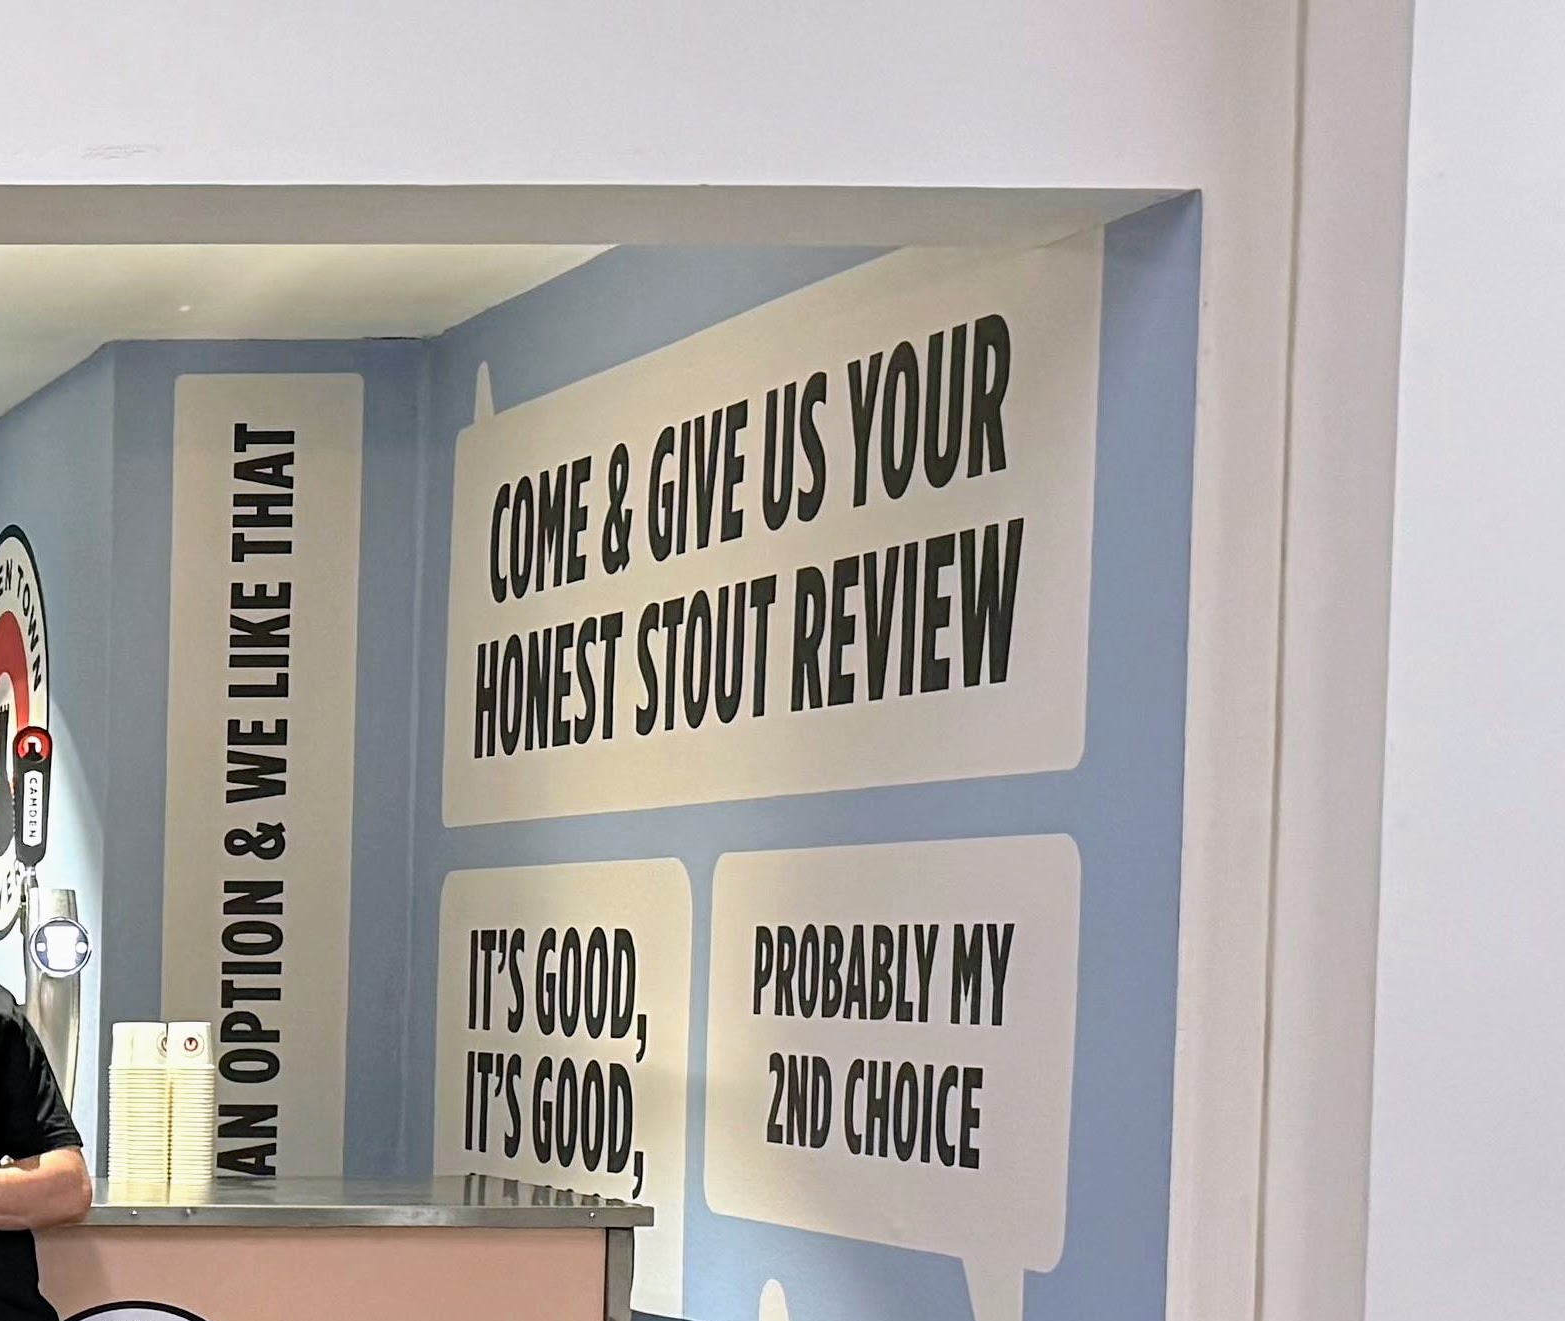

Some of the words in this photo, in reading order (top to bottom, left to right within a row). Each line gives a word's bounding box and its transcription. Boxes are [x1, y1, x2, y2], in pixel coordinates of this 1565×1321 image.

[232, 423, 295, 563] THAT
[489, 456, 592, 604] COME
[601, 443, 633, 573] &
[648, 399, 748, 561] GIVE
[762, 371, 828, 531] US
[847, 314, 1010, 508] YOUR
[16, 565, 42, 693] TOWN
[228, 582, 292, 698] LIKE
[474, 611, 623, 759] HONEST
[635, 574, 777, 736] STOUT
[790, 517, 1024, 712] REVIEW
[28, 776, 39, 838] CAMDEN
[226, 718, 288, 804] WE
[225, 822, 286, 859] &
[218, 880, 284, 1084] OPTION
[468, 929, 525, 1035] IT'S
[536, 927, 647, 1063] GOOD,
[753, 924, 939, 1024] PROBABLY
[950, 923, 1015, 1026] MY
[216, 1104, 277, 1177] AN
[464, 1051, 522, 1159] IT'S
[533, 1057, 644, 1200] GOOD,
[766, 1052, 832, 1149] 2ND
[844, 1059, 983, 1170] CHOICE
